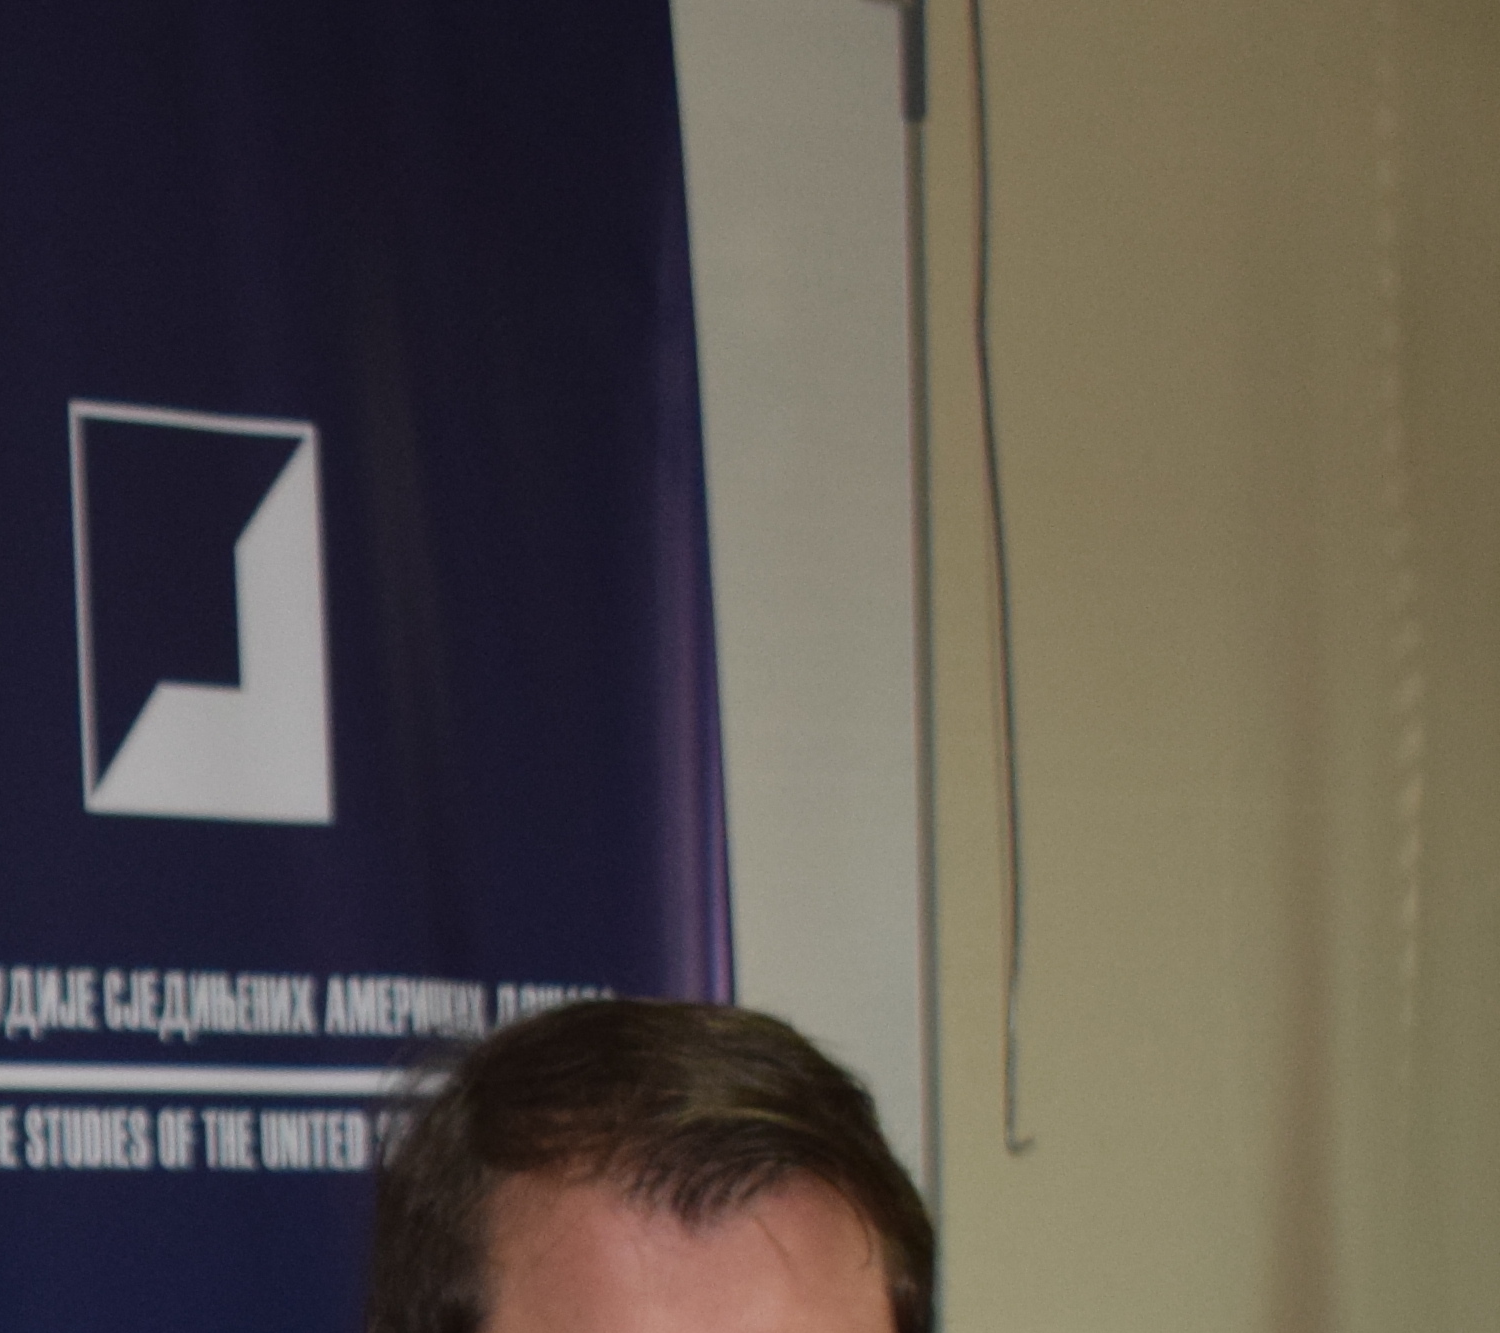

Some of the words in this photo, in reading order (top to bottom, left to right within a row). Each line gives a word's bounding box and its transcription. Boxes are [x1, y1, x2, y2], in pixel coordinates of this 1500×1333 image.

[103, 967, 316, 1043] СЈЕДИЊЕНИХ
[24, 1106, 151, 1169] STUDIES
[157, 1106, 197, 1169] OF
[202, 1108, 256, 1169] THE
[260, 1109, 368, 1171] UNITED
